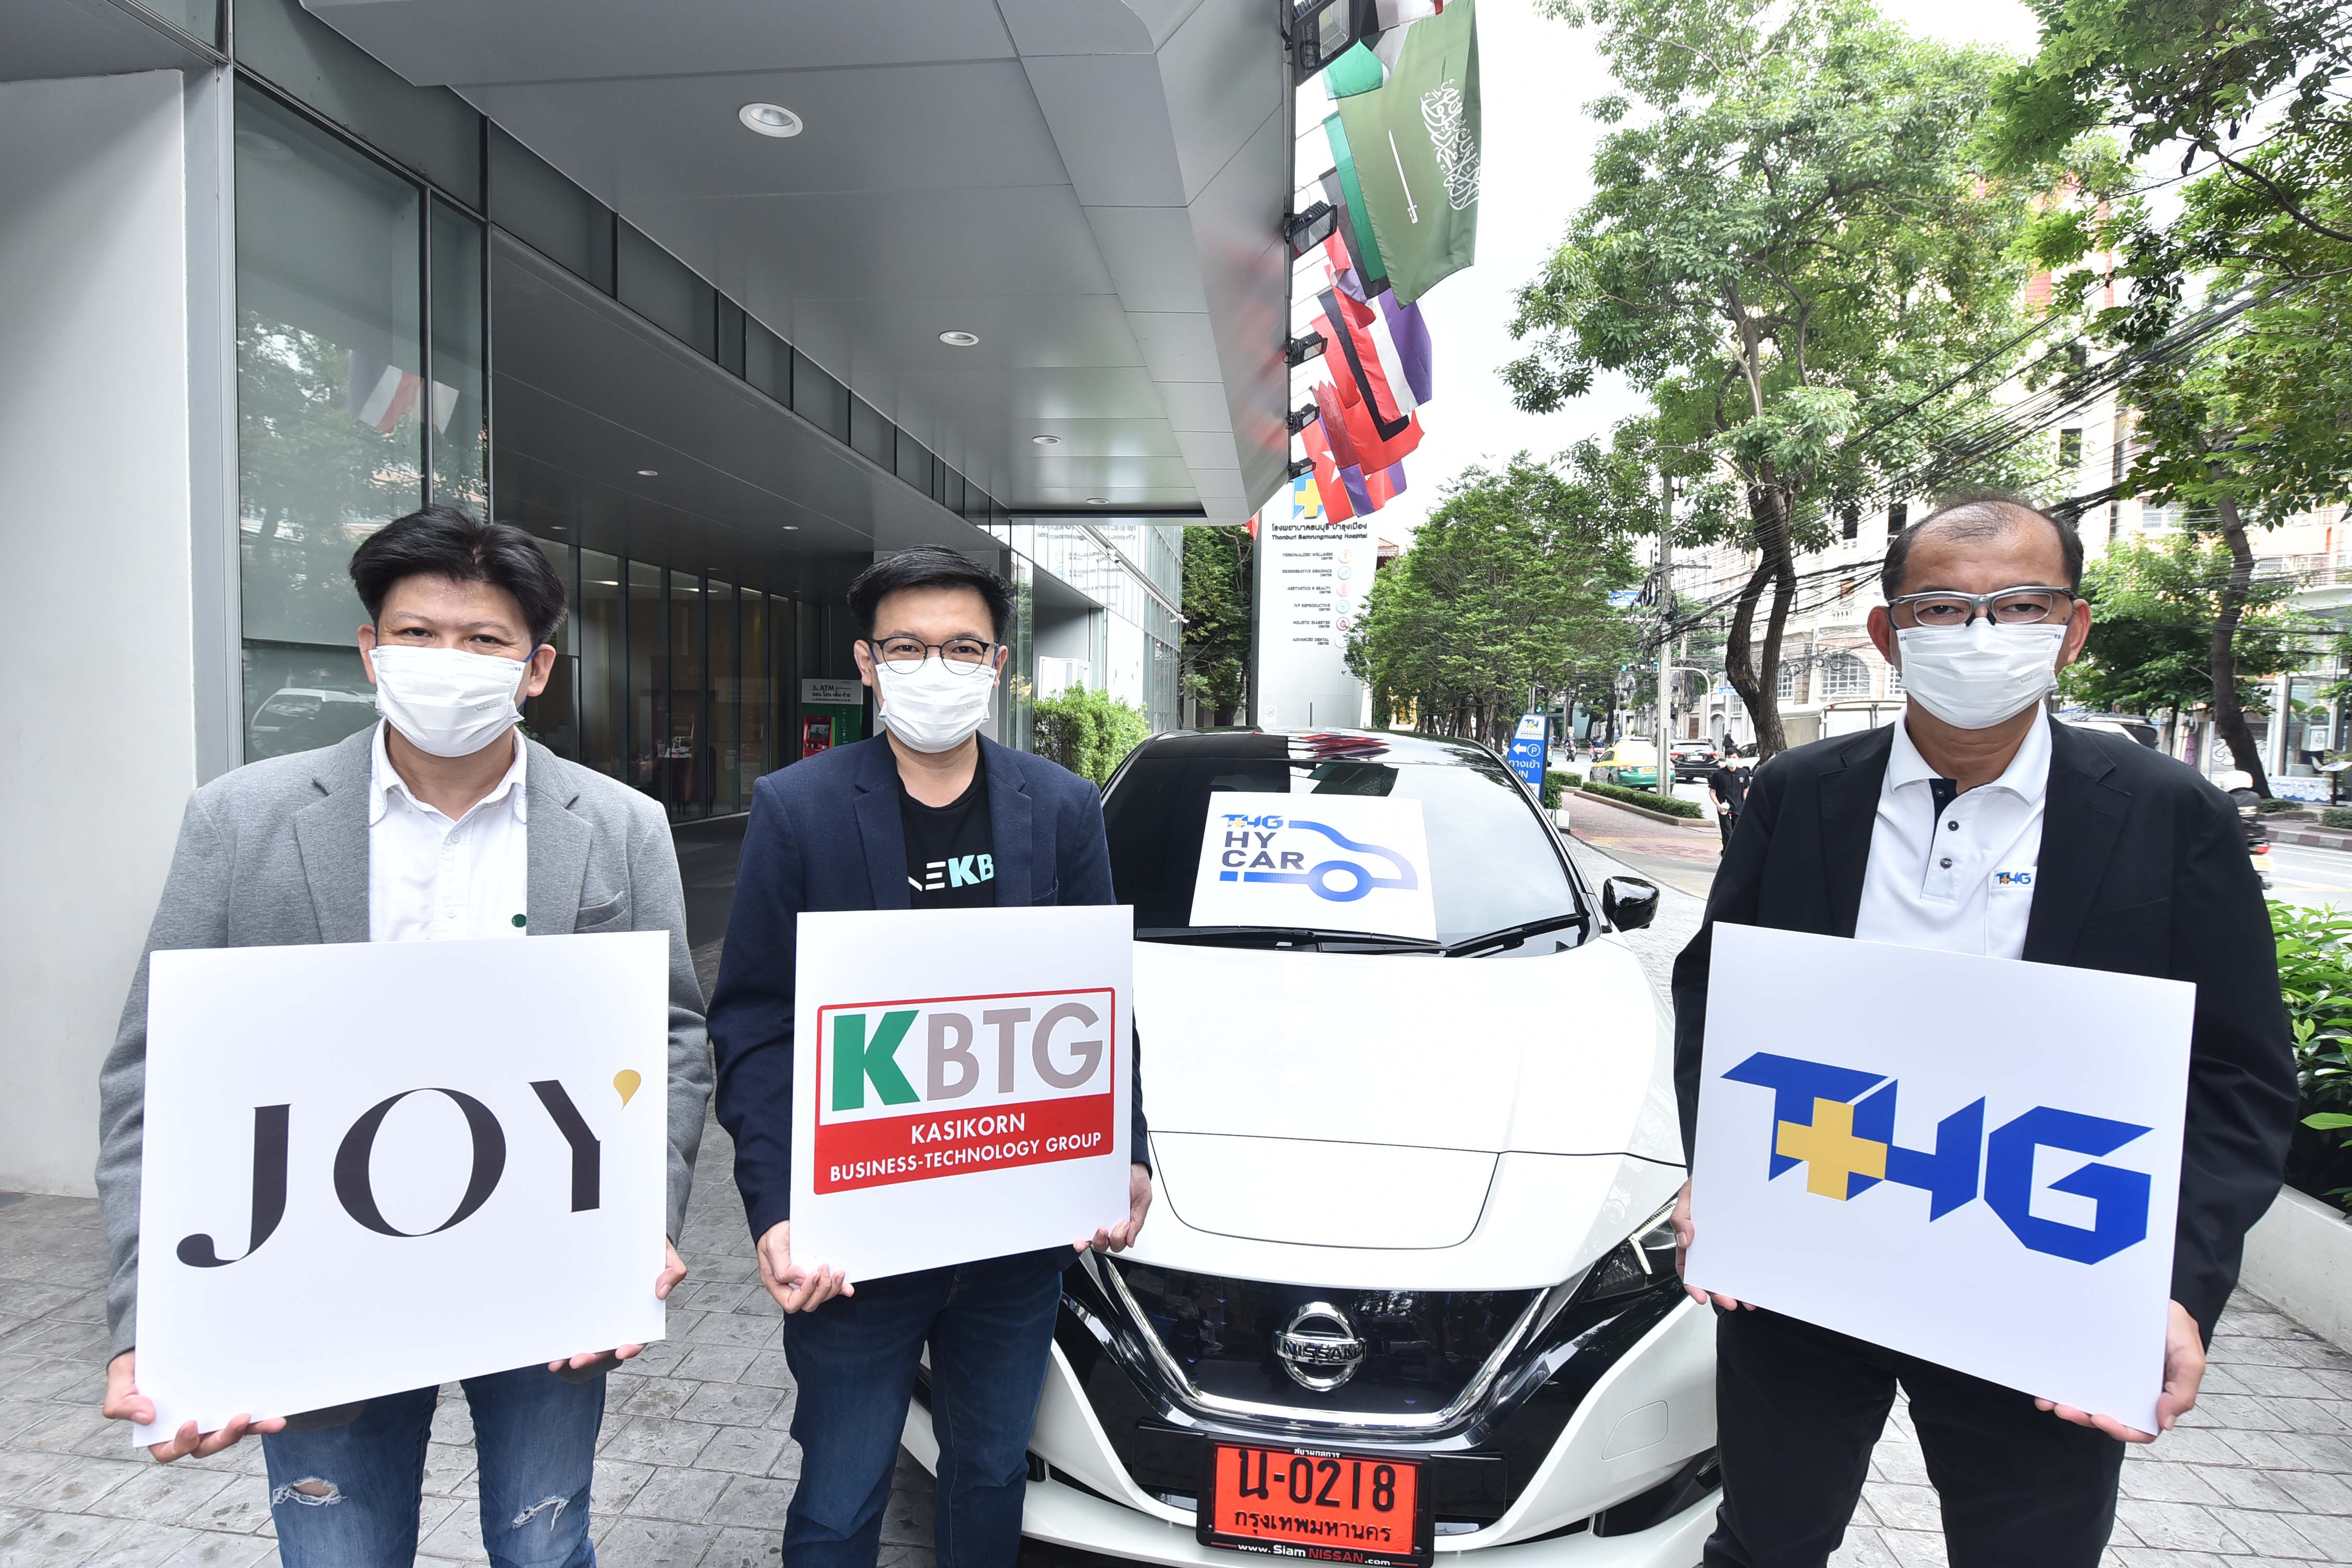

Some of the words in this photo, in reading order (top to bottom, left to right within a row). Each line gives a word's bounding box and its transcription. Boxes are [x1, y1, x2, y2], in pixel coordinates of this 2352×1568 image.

[1224, 831, 1277, 849] HY
[1221, 850, 1305, 870] CAR
[832, 1002, 1103, 1112] KBTG
[911, 1112, 1025, 1145] KASIKORN
[830, 1140, 1039, 1182] BUSINESS-TECHNOLOGY
[1046, 1132, 1101, 1152] GROUP
[1720, 1051, 2154, 1266] THG
[1284, 1342, 1355, 1364] NISSAN
[1234, 1510, 1391, 1542] กรุงเทพมหานคร
